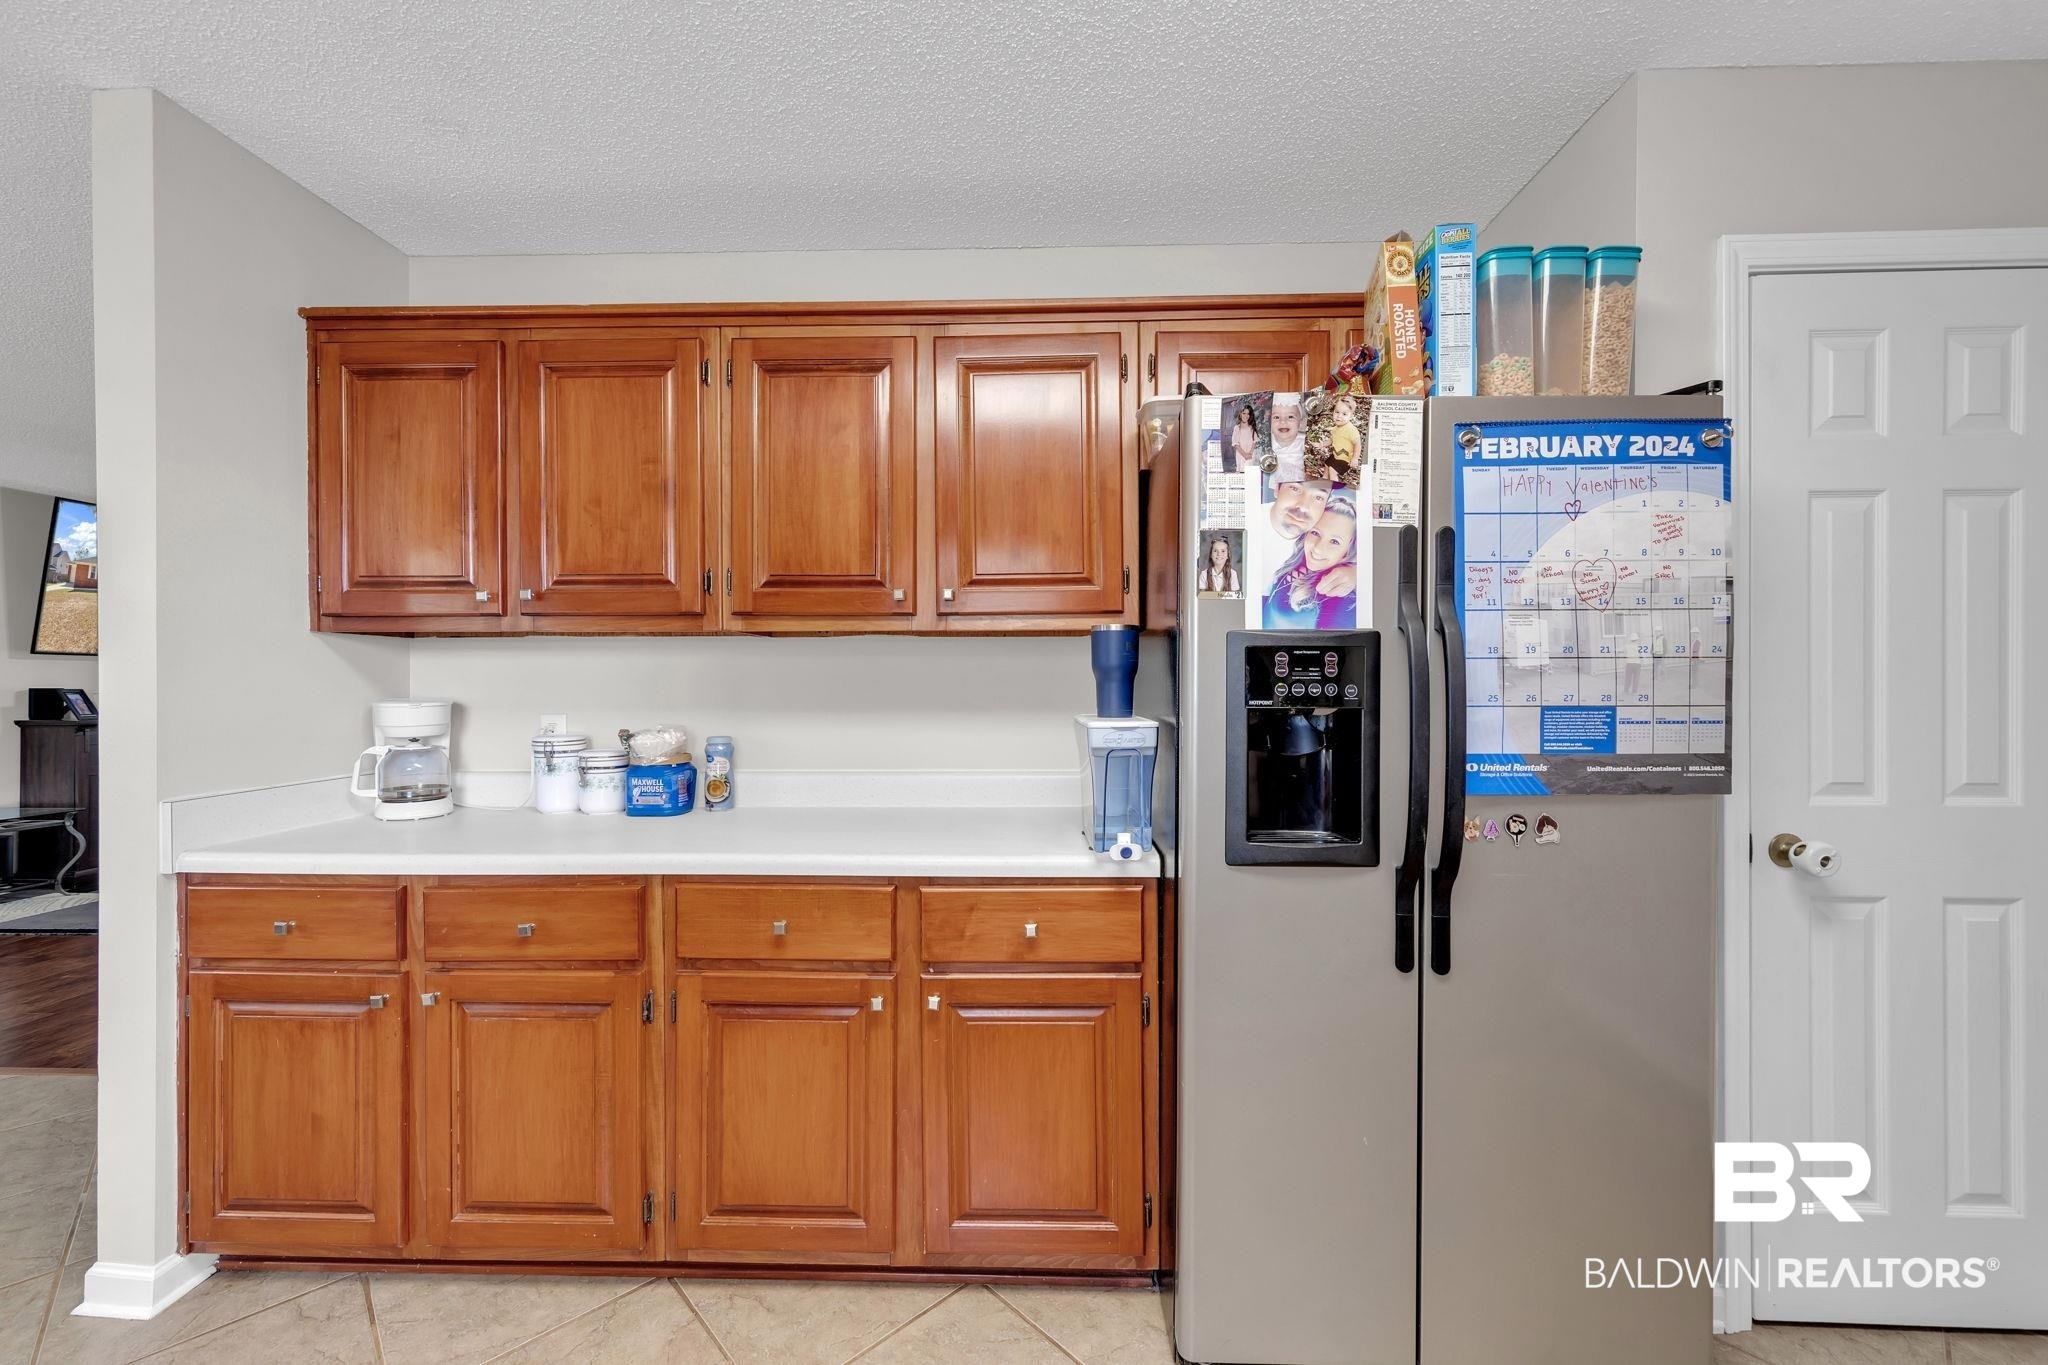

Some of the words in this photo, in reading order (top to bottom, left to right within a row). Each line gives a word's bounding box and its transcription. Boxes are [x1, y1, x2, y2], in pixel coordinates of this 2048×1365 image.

[1393, 303, 1407, 359] ROASTED
[1405, 309, 1417, 351] HONEY
[1629, 435, 1695, 457] 2024
[1491, 550, 1496, 558] 4
[1528, 550, 1533, 558] 5
[1565, 550, 1571, 558] 6
[1711, 548, 1721, 556] 10
[1487, 598, 1497, 606] 11
[1524, 598, 1534, 606] 12
[1561, 598, 1571, 606] 13
[1598, 597, 1609, 605] 14
[1636, 597, 1647, 605] 15
[1673, 597, 1685, 605] 16
[1711, 597, 1722, 605] 17
[1488, 646, 1499, 654] 18
[1526, 646, 1536, 654] 19
[1562, 646, 1574, 654] 20
[1600, 645, 1611, 653] 21
[1638, 645, 1649, 653] 22
[1675, 645, 1686, 653] 23
[1712, 645, 1722, 653] 24
[1488, 694, 1499, 702] 25
[1526, 694, 1537, 702] 26
[1563, 694, 1574, 702] 27
[1601, 694, 1612, 702] 28
[1638, 694, 1649, 702] 29
[1480, 763, 1511, 772] United
[1513, 763, 1548, 772] Rentals
[631, 778, 664, 786] MAXWELL
[641, 785, 664, 793] HOUSE
